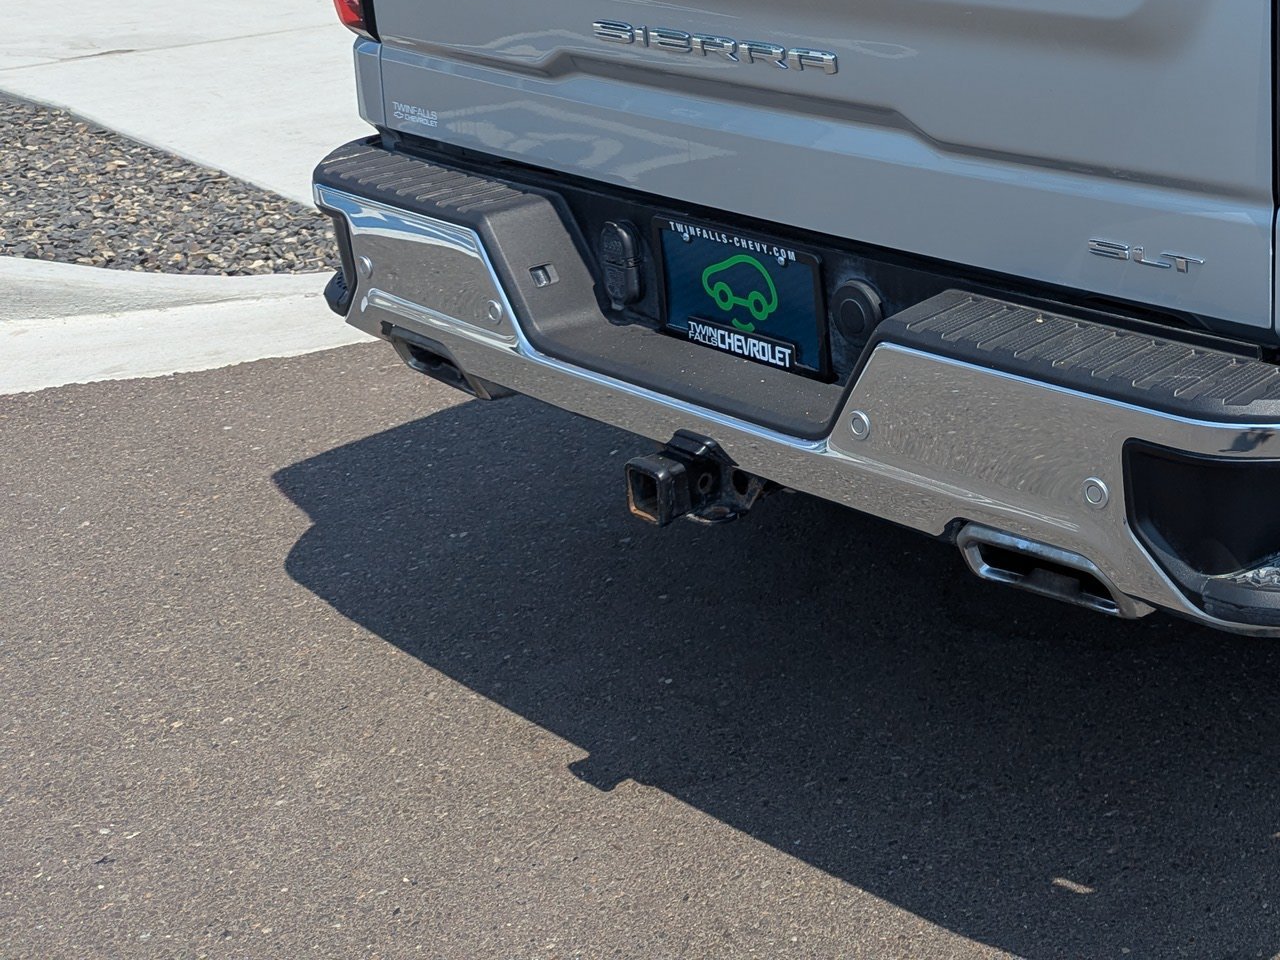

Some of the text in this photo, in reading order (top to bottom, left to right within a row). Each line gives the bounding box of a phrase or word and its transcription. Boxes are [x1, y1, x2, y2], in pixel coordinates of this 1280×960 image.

[592, 19, 839, 75] SIERRA
[404, 113, 438, 128] CHEVROLET
[1088, 238, 1205, 273] SLT
[687, 320, 717, 338] TWIN
[688, 331, 718, 347] FALLS
[717, 329, 792, 367] CHEVROLET
